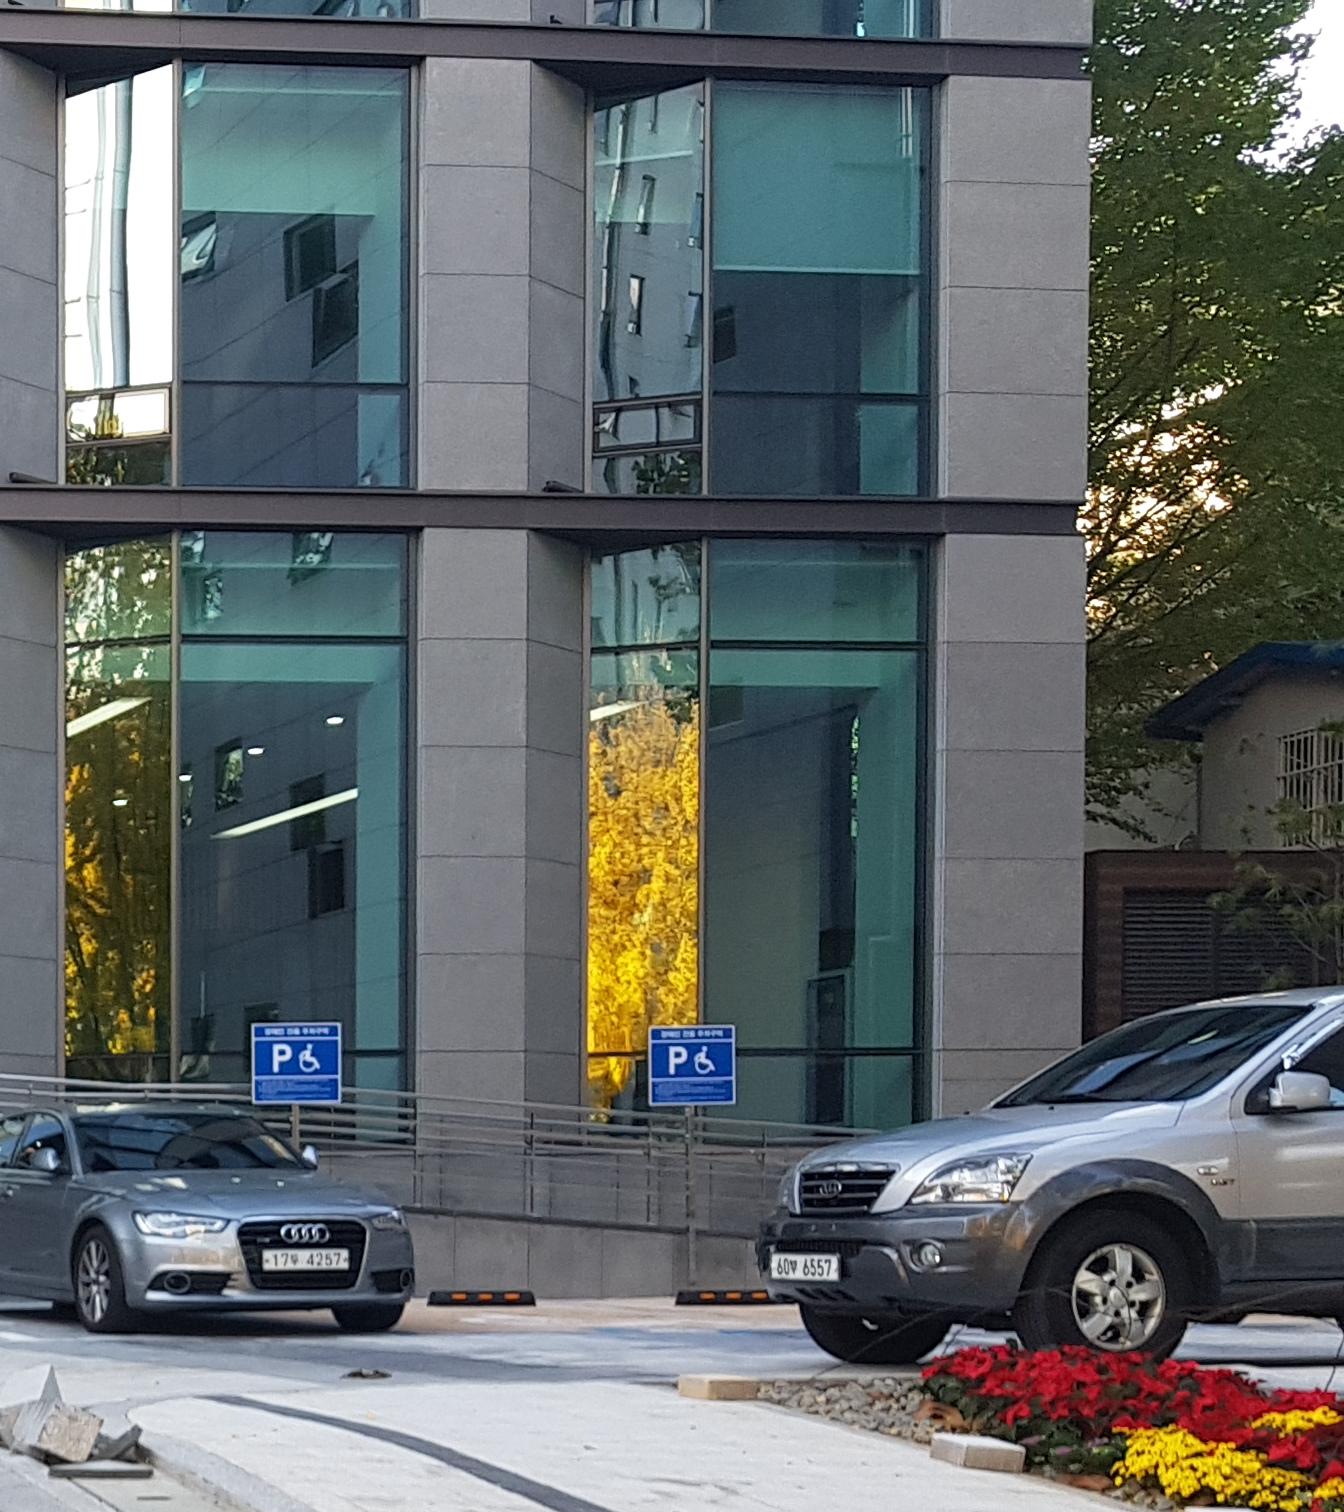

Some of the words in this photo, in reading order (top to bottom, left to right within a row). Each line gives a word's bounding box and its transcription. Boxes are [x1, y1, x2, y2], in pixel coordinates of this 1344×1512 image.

[272, 1044, 292, 1073] P
[668, 1046, 688, 1075] P
[307, 1252, 341, 1267] 4257
[802, 1258, 832, 1277] 6557
